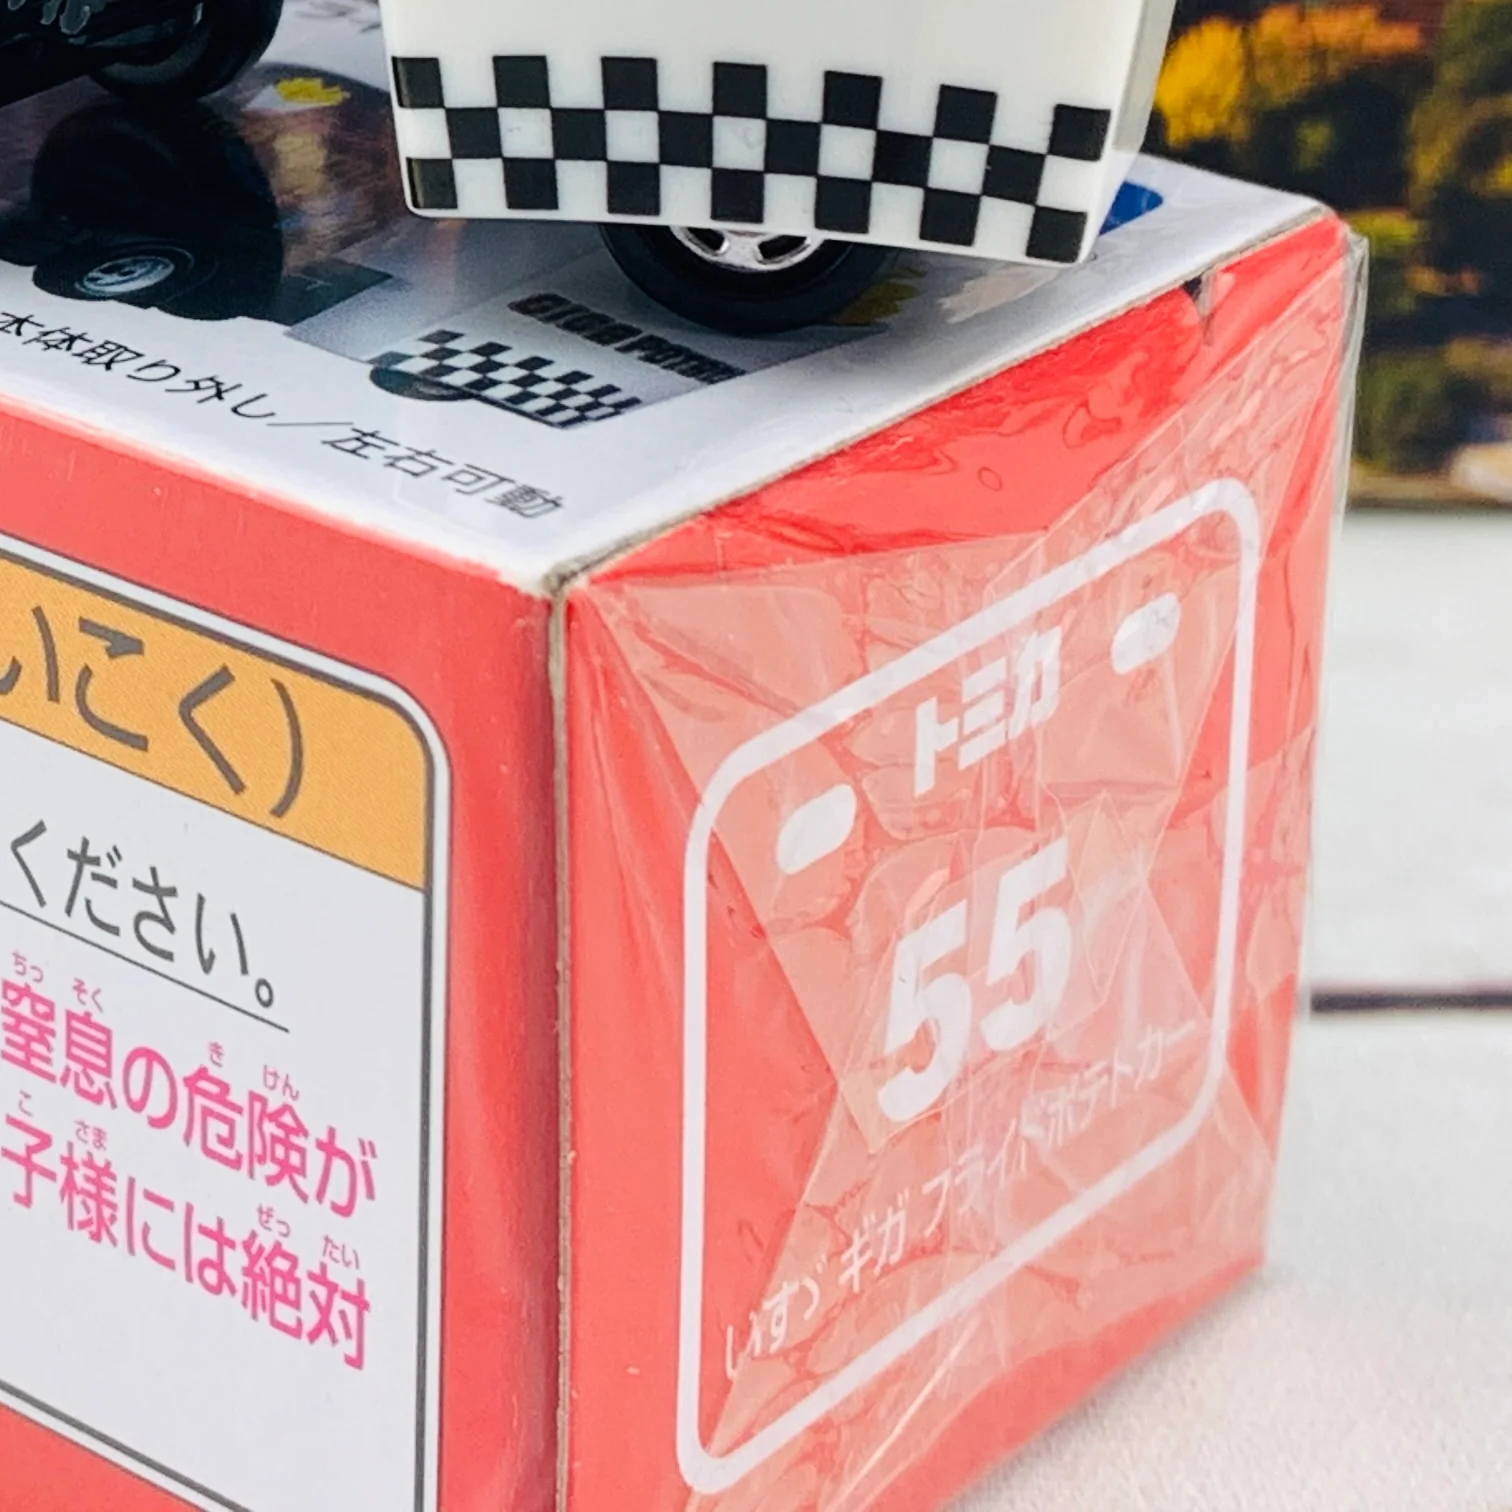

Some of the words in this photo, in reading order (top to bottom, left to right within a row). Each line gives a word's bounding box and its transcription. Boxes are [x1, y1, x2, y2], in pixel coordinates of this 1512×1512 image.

[913, 624, 1062, 799] トミカ
[72, 977, 104, 1014] そく
[263, 1064, 300, 1101] けん
[877, 836, 1073, 1124] 55
[322, 1234, 361, 1271] たい
[839, 1187, 910, 1294] ギガ
